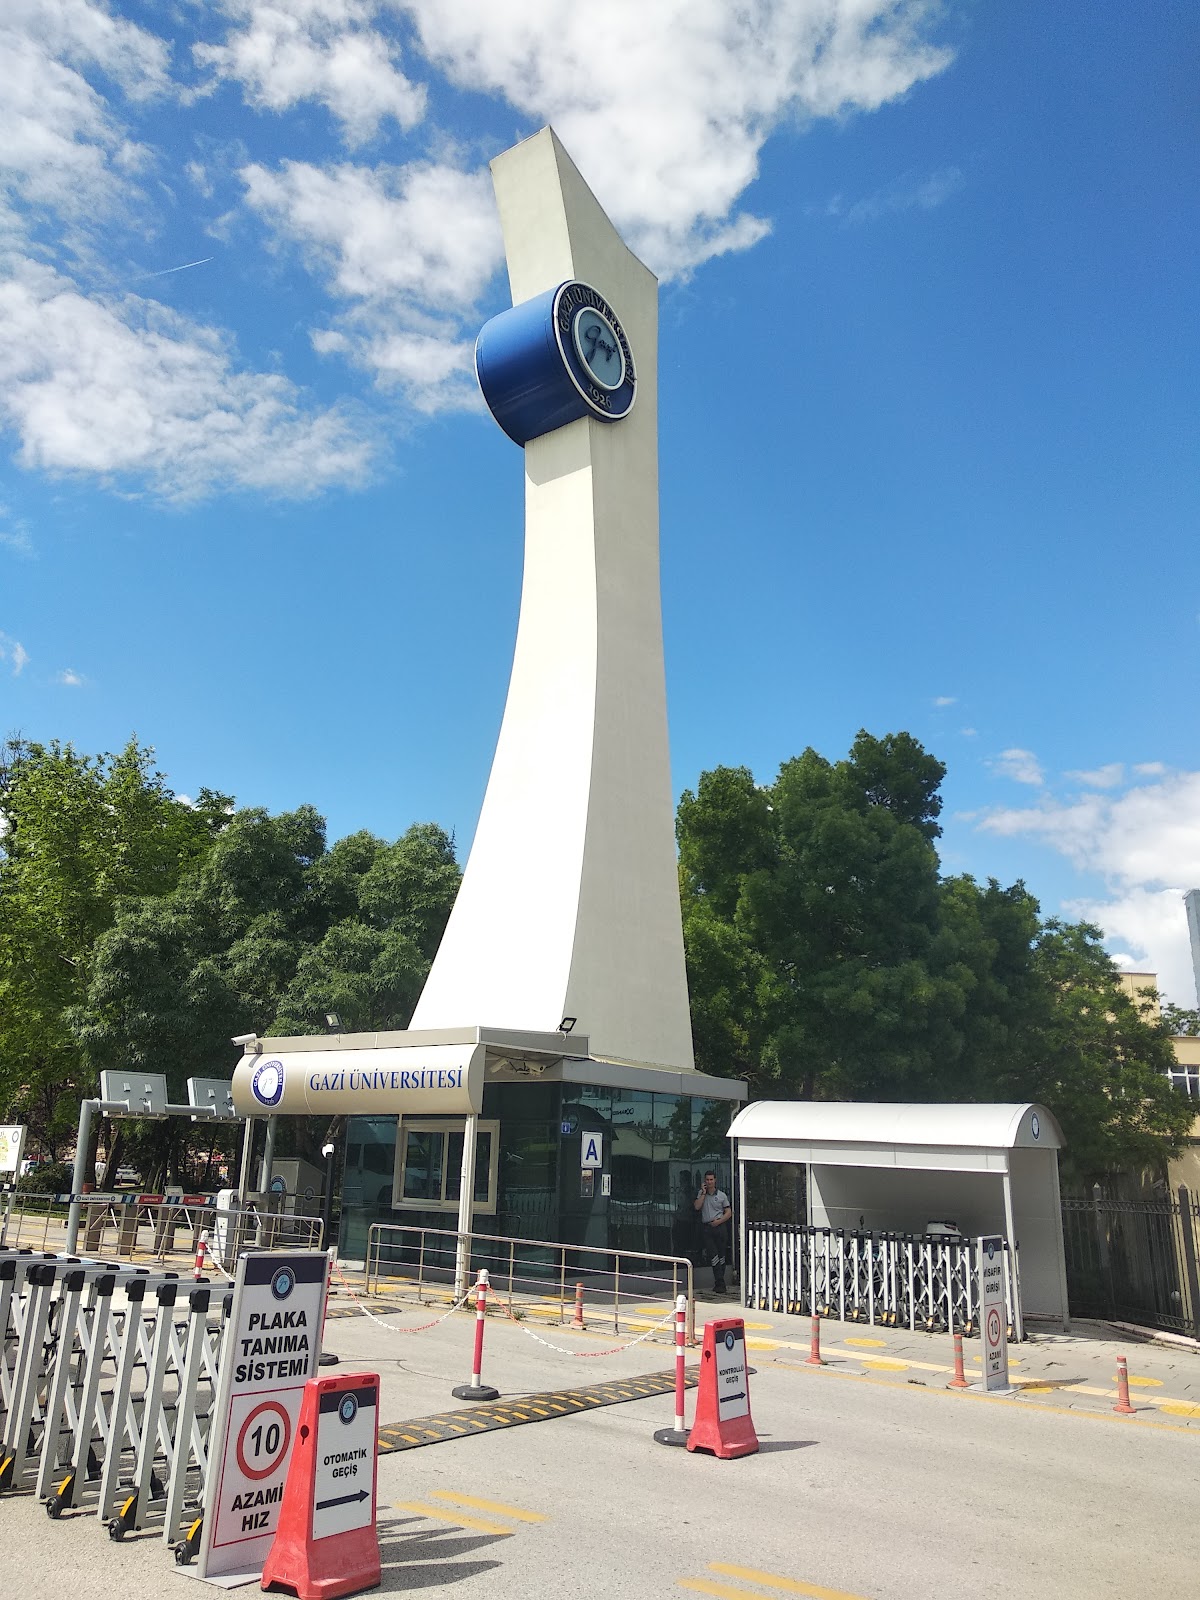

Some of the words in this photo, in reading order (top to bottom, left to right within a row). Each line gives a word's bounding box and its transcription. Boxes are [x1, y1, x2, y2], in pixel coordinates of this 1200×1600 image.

[588, 383, 612, 409] 1926
[310, 1069, 345, 1091] GAZİ
[350, 1065, 463, 1090] ÜNİVERSİTESİ
[585, 1138, 598, 1161] A
[248, 1310, 307, 1331] PLAKA
[990, 1319, 998, 1336] 10
[241, 1334, 309, 1357] TANIMA
[235, 1354, 309, 1383] SİSTEMİ
[251, 1423, 280, 1456] 10
[323, 1447, 368, 1466] OTOMATİK
[332, 1463, 358, 1478] GEÇİŞ
[231, 1482, 283, 1512] AZAMİ
[241, 1511, 270, 1532] HIZ
